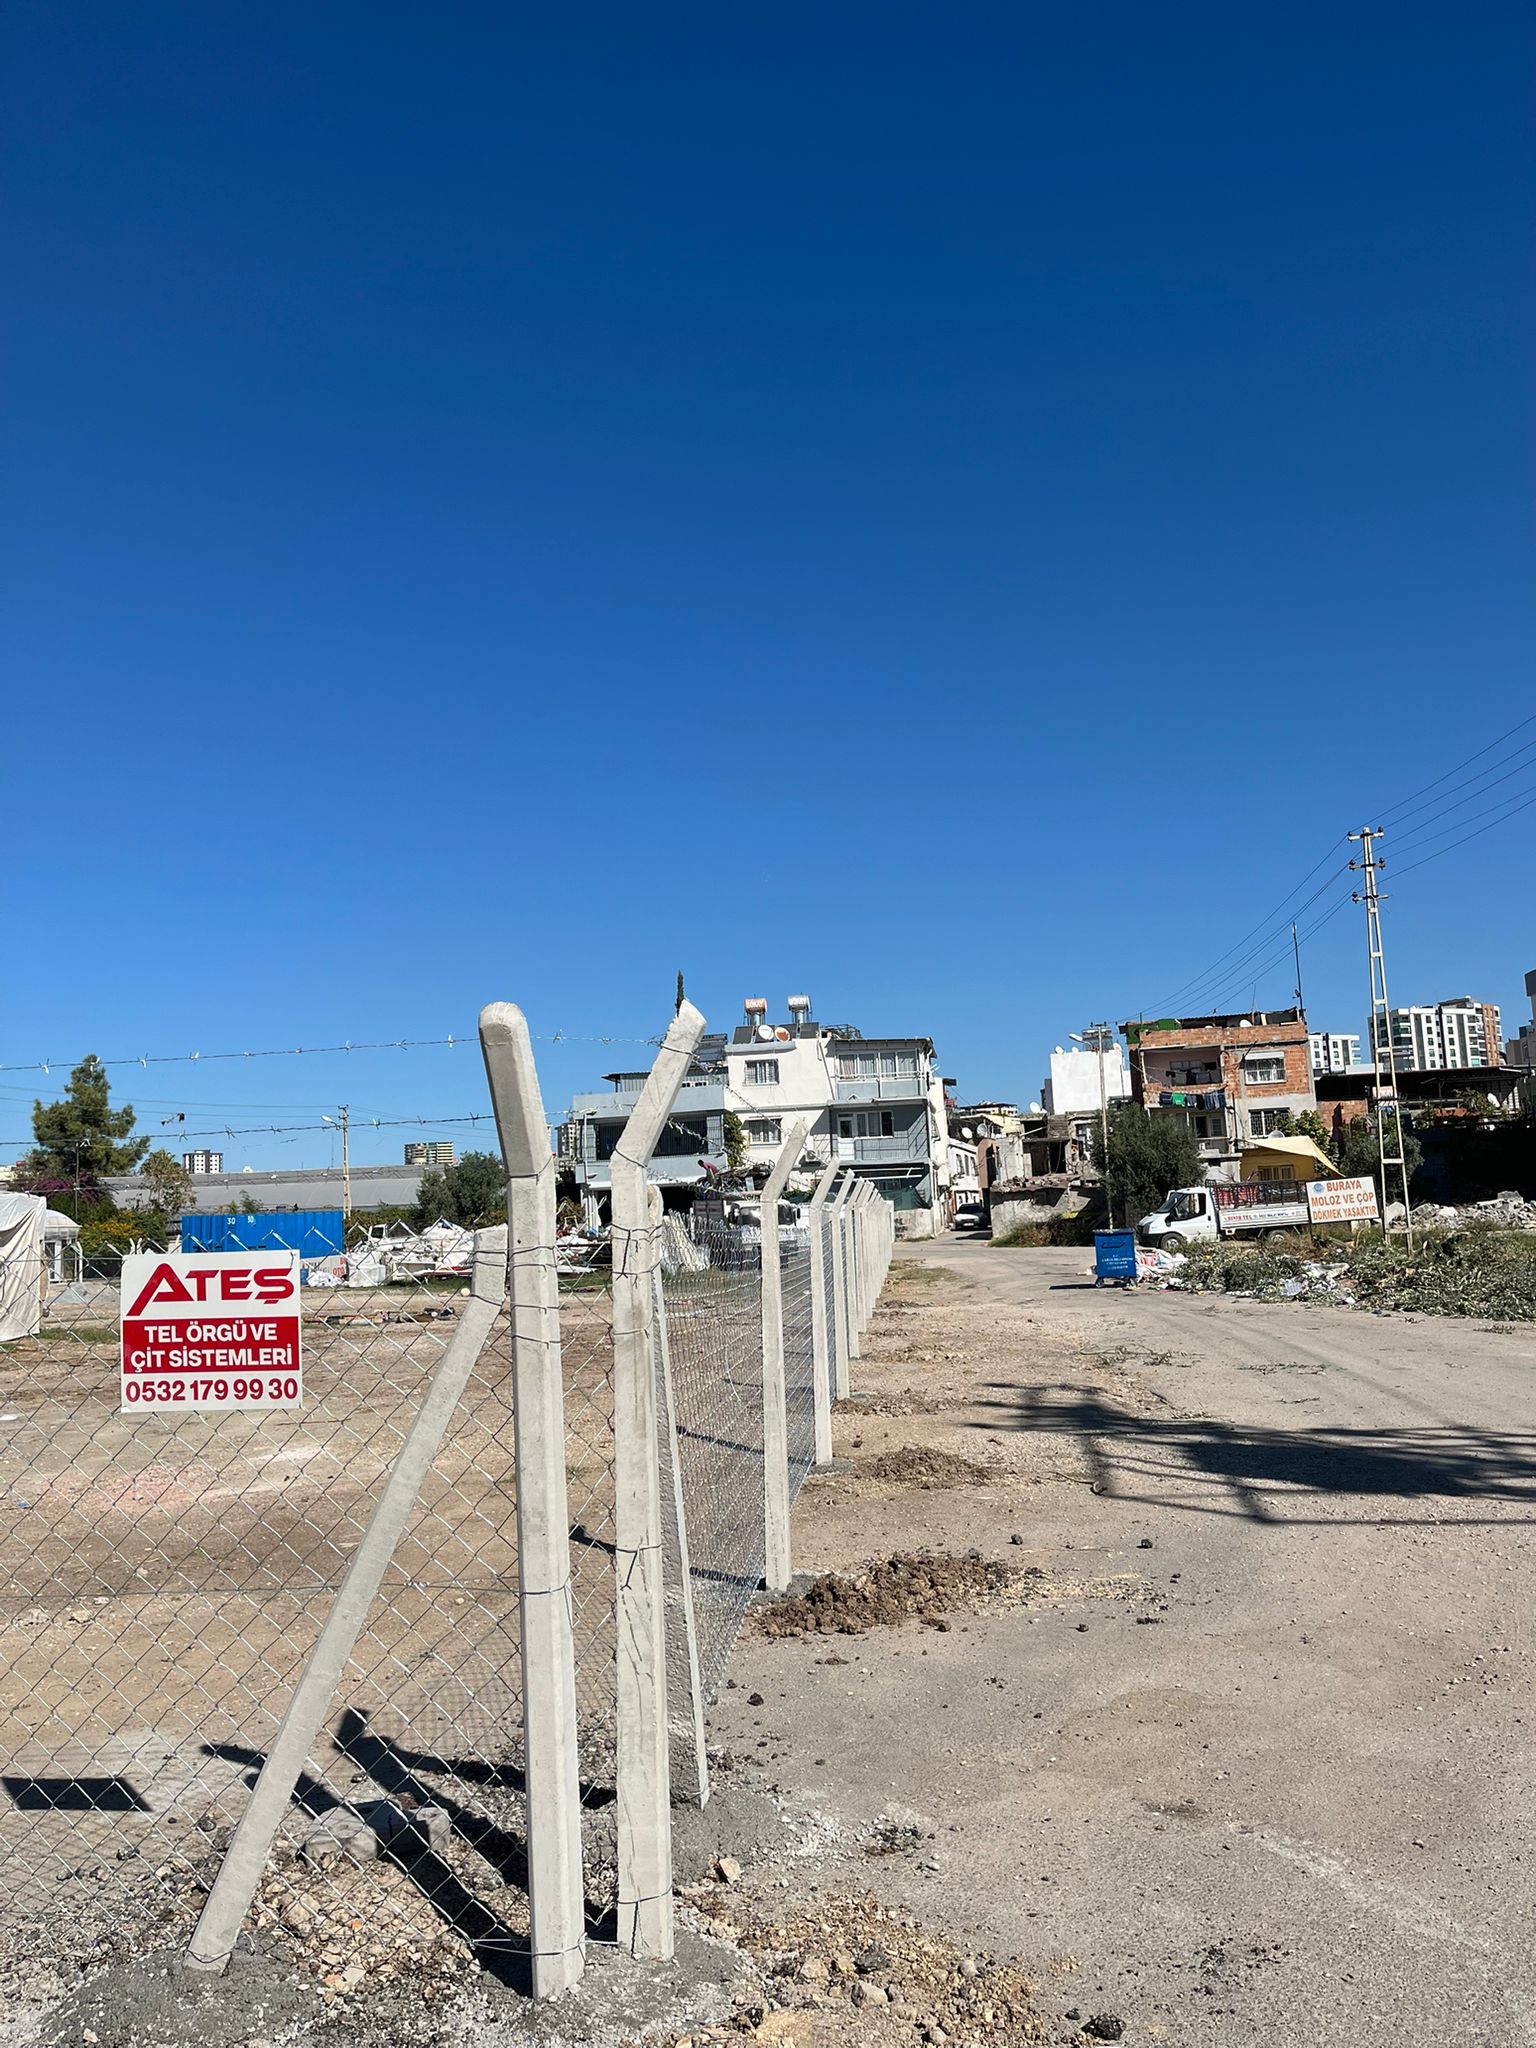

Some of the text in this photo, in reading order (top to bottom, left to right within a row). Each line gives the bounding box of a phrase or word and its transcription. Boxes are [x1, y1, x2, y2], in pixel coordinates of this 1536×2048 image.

[1326, 1179, 1362, 1192] BURAYA
[1311, 1195, 1341, 1207] MOLOZ
[1343, 1193, 1355, 1204] VE
[1343, 1205, 1377, 1218] YASAKTIR
[126, 1263, 294, 1316] ATEŞ
[144, 1320, 277, 1343] TEL ÖRGÜ VE
[130, 1343, 293, 1373] ÇİT SİSTEMLERİ
[125, 1378, 298, 1402] 0532 179 99 30
